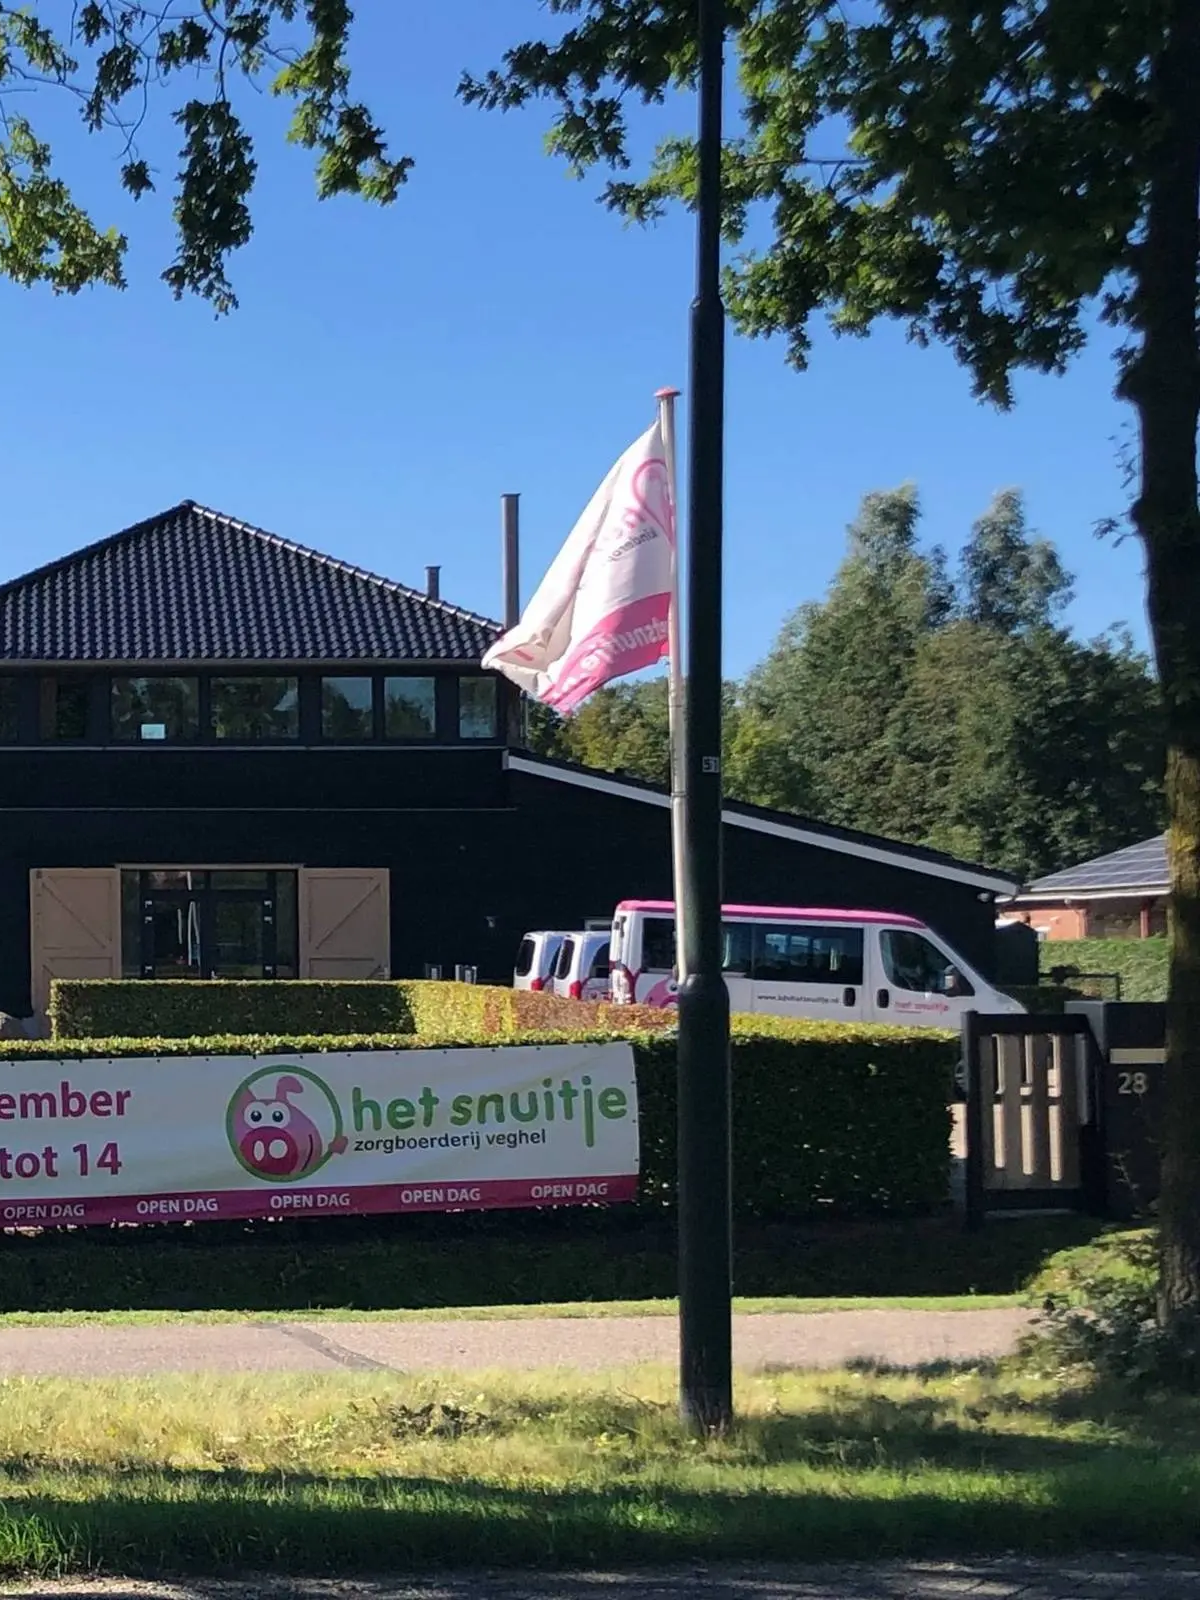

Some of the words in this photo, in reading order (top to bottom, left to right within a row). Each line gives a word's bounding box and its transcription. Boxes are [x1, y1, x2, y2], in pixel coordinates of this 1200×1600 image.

[1118, 1072, 1148, 1094] 28
[352, 1086, 440, 1132] het
[450, 1075, 628, 1150] snuitje
[353, 1133, 481, 1154] zorgboerderij
[485, 1128, 546, 1149] veghel
[72, 1142, 122, 1177] 14
[401, 1189, 444, 1203] OPEN
[447, 1187, 481, 1202] DAG
[530, 1184, 573, 1199] OPEN
[576, 1182, 608, 1196] DAG
[136, 1199, 180, 1214] OPEN
[184, 1198, 219, 1212] DAG
[270, 1194, 315, 1209] OPEN
[317, 1193, 350, 1207] DAG
[3, 1205, 47, 1220] OPEN
[50, 1203, 85, 1218] DAG
